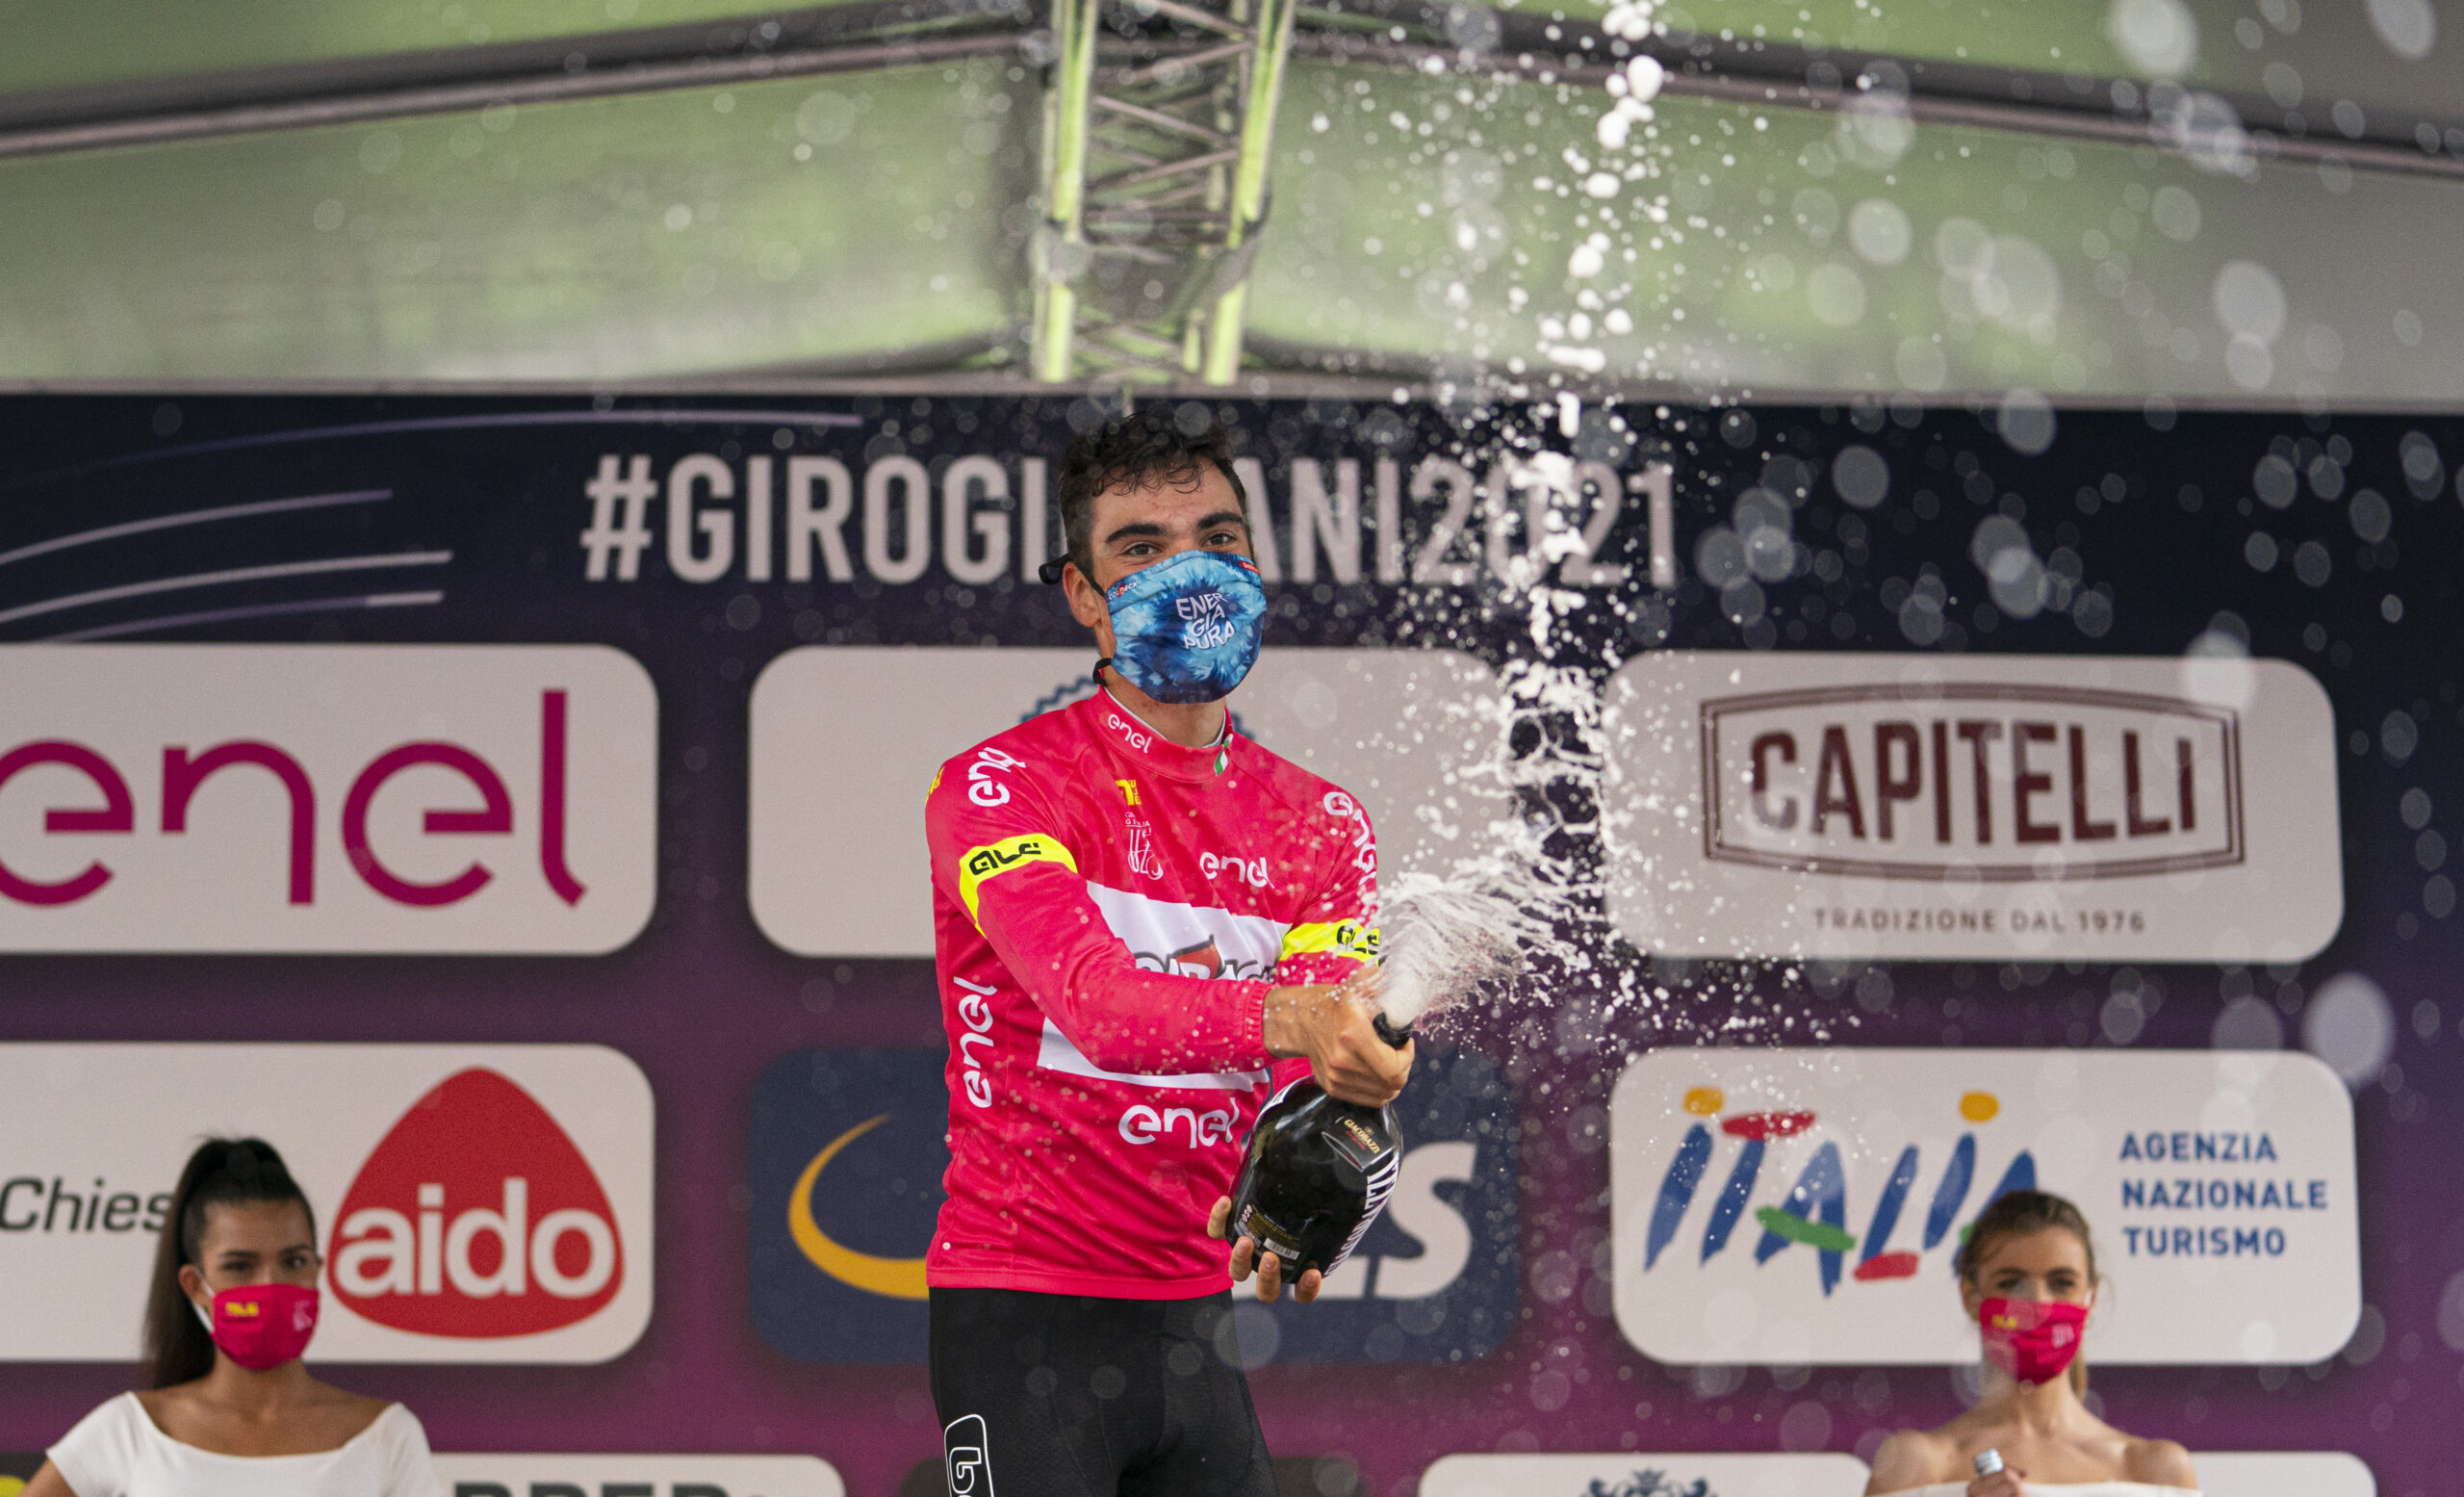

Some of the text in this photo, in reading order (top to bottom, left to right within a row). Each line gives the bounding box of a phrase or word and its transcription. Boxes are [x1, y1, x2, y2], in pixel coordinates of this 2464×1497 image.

[582, 453, 1676, 586] #GIROGIANI2021
[1175, 592, 1228, 620] ENER
[1192, 605, 1225, 636] GIA
[1183, 620, 1235, 650] PURA
[1108, 713, 1152, 754] enel
[0, 689, 588, 908] enel
[1749, 716, 2198, 845] CAPITELLI
[1815, 908, 2145, 933] TRADIZIONE DAL 1976
[953, 976, 998, 1108] enel
[1117, 1097, 1241, 1149] enel
[2120, 1132, 2278, 1162] AGENZIA
[2121, 1179, 2328, 1209] NAZIONALE
[335, 1177, 616, 1299] aido
[2123, 1226, 2287, 1257] TURISMO
